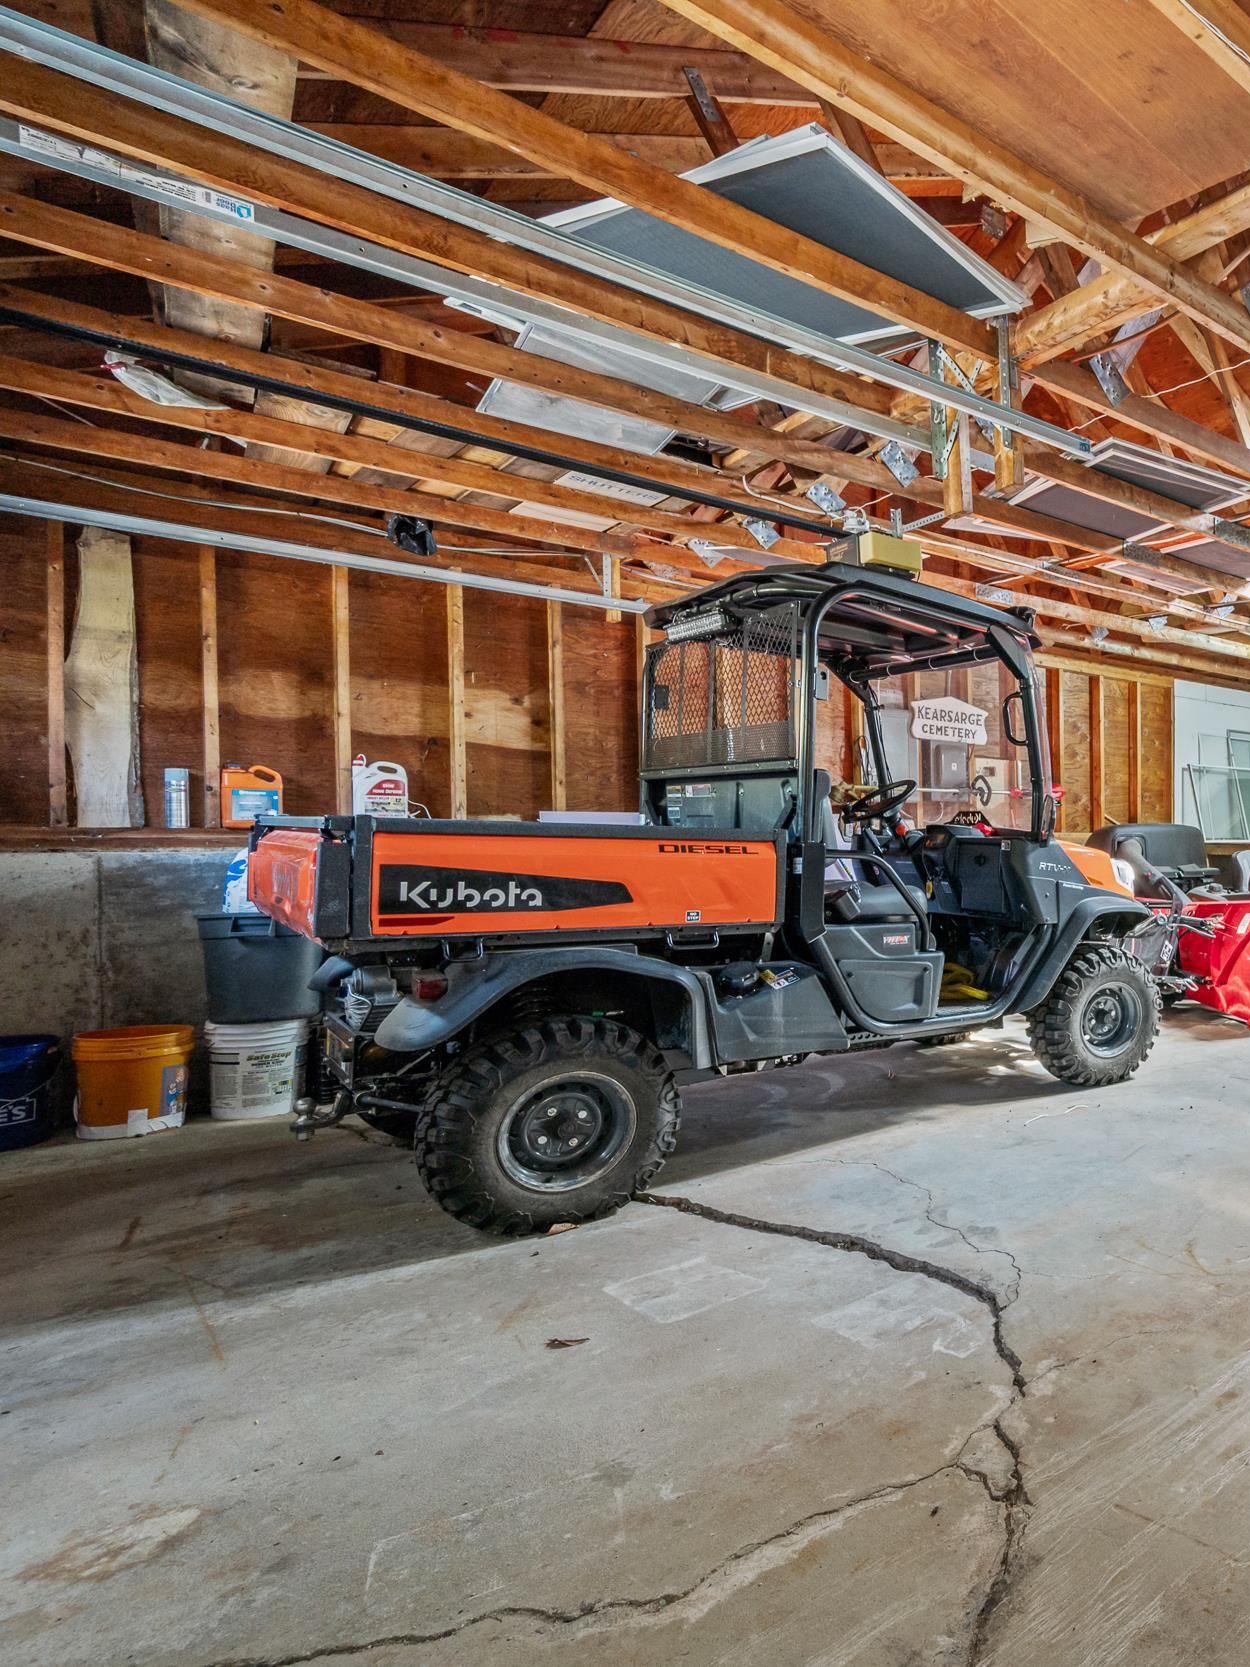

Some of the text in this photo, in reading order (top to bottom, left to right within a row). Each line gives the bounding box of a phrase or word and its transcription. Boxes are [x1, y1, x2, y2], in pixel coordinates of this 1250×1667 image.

[568, 475, 660, 500] SHUTTERS
[917, 705, 983, 727] KEARSARGE
[922, 723, 977, 740] CEMETERY
[658, 844, 759, 855] DIESEL
[399, 881, 543, 909] Kubota
